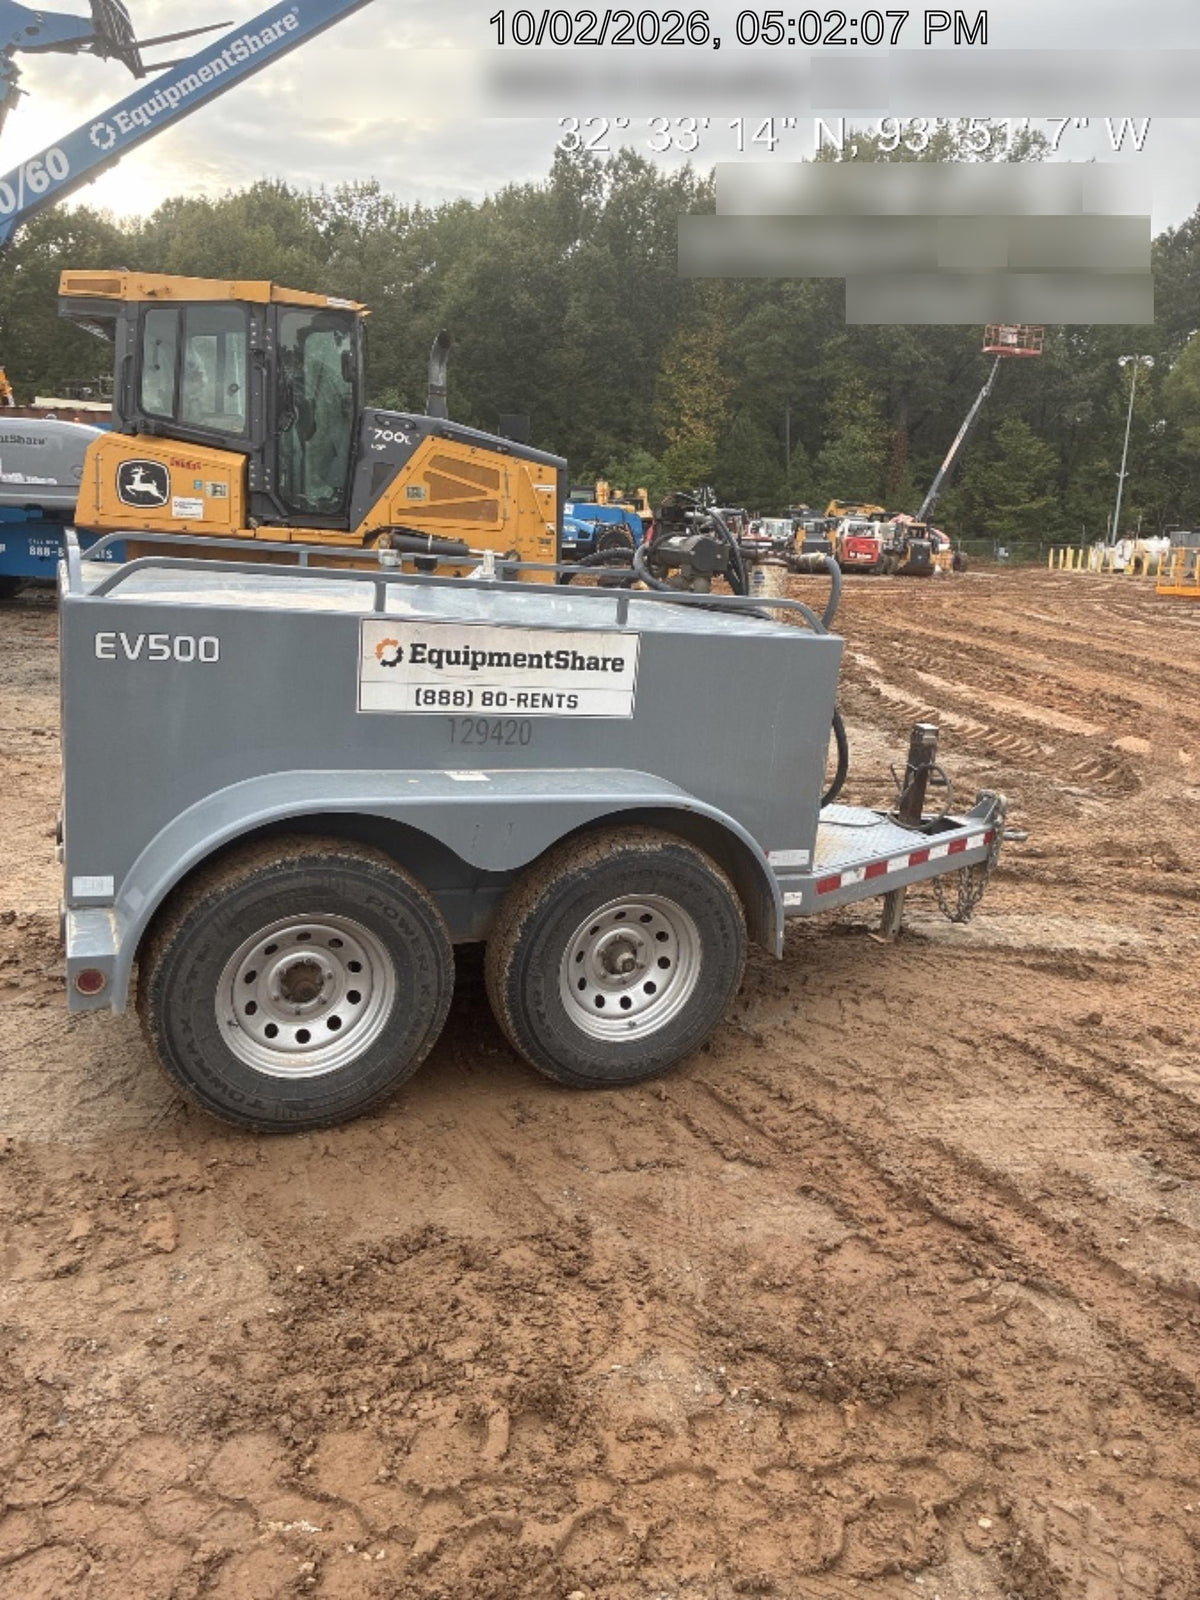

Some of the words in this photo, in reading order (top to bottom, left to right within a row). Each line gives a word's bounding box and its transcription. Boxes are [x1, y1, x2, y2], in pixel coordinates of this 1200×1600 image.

[114, 13, 299, 134] EquipmentShare
[95, 632, 220, 662] EV500
[408, 643, 625, 672] EquipmentShare
[415, 688, 473, 708] (888)
[481, 691, 579, 709] 80-RENTS
[447, 717, 532, 746] 129420
